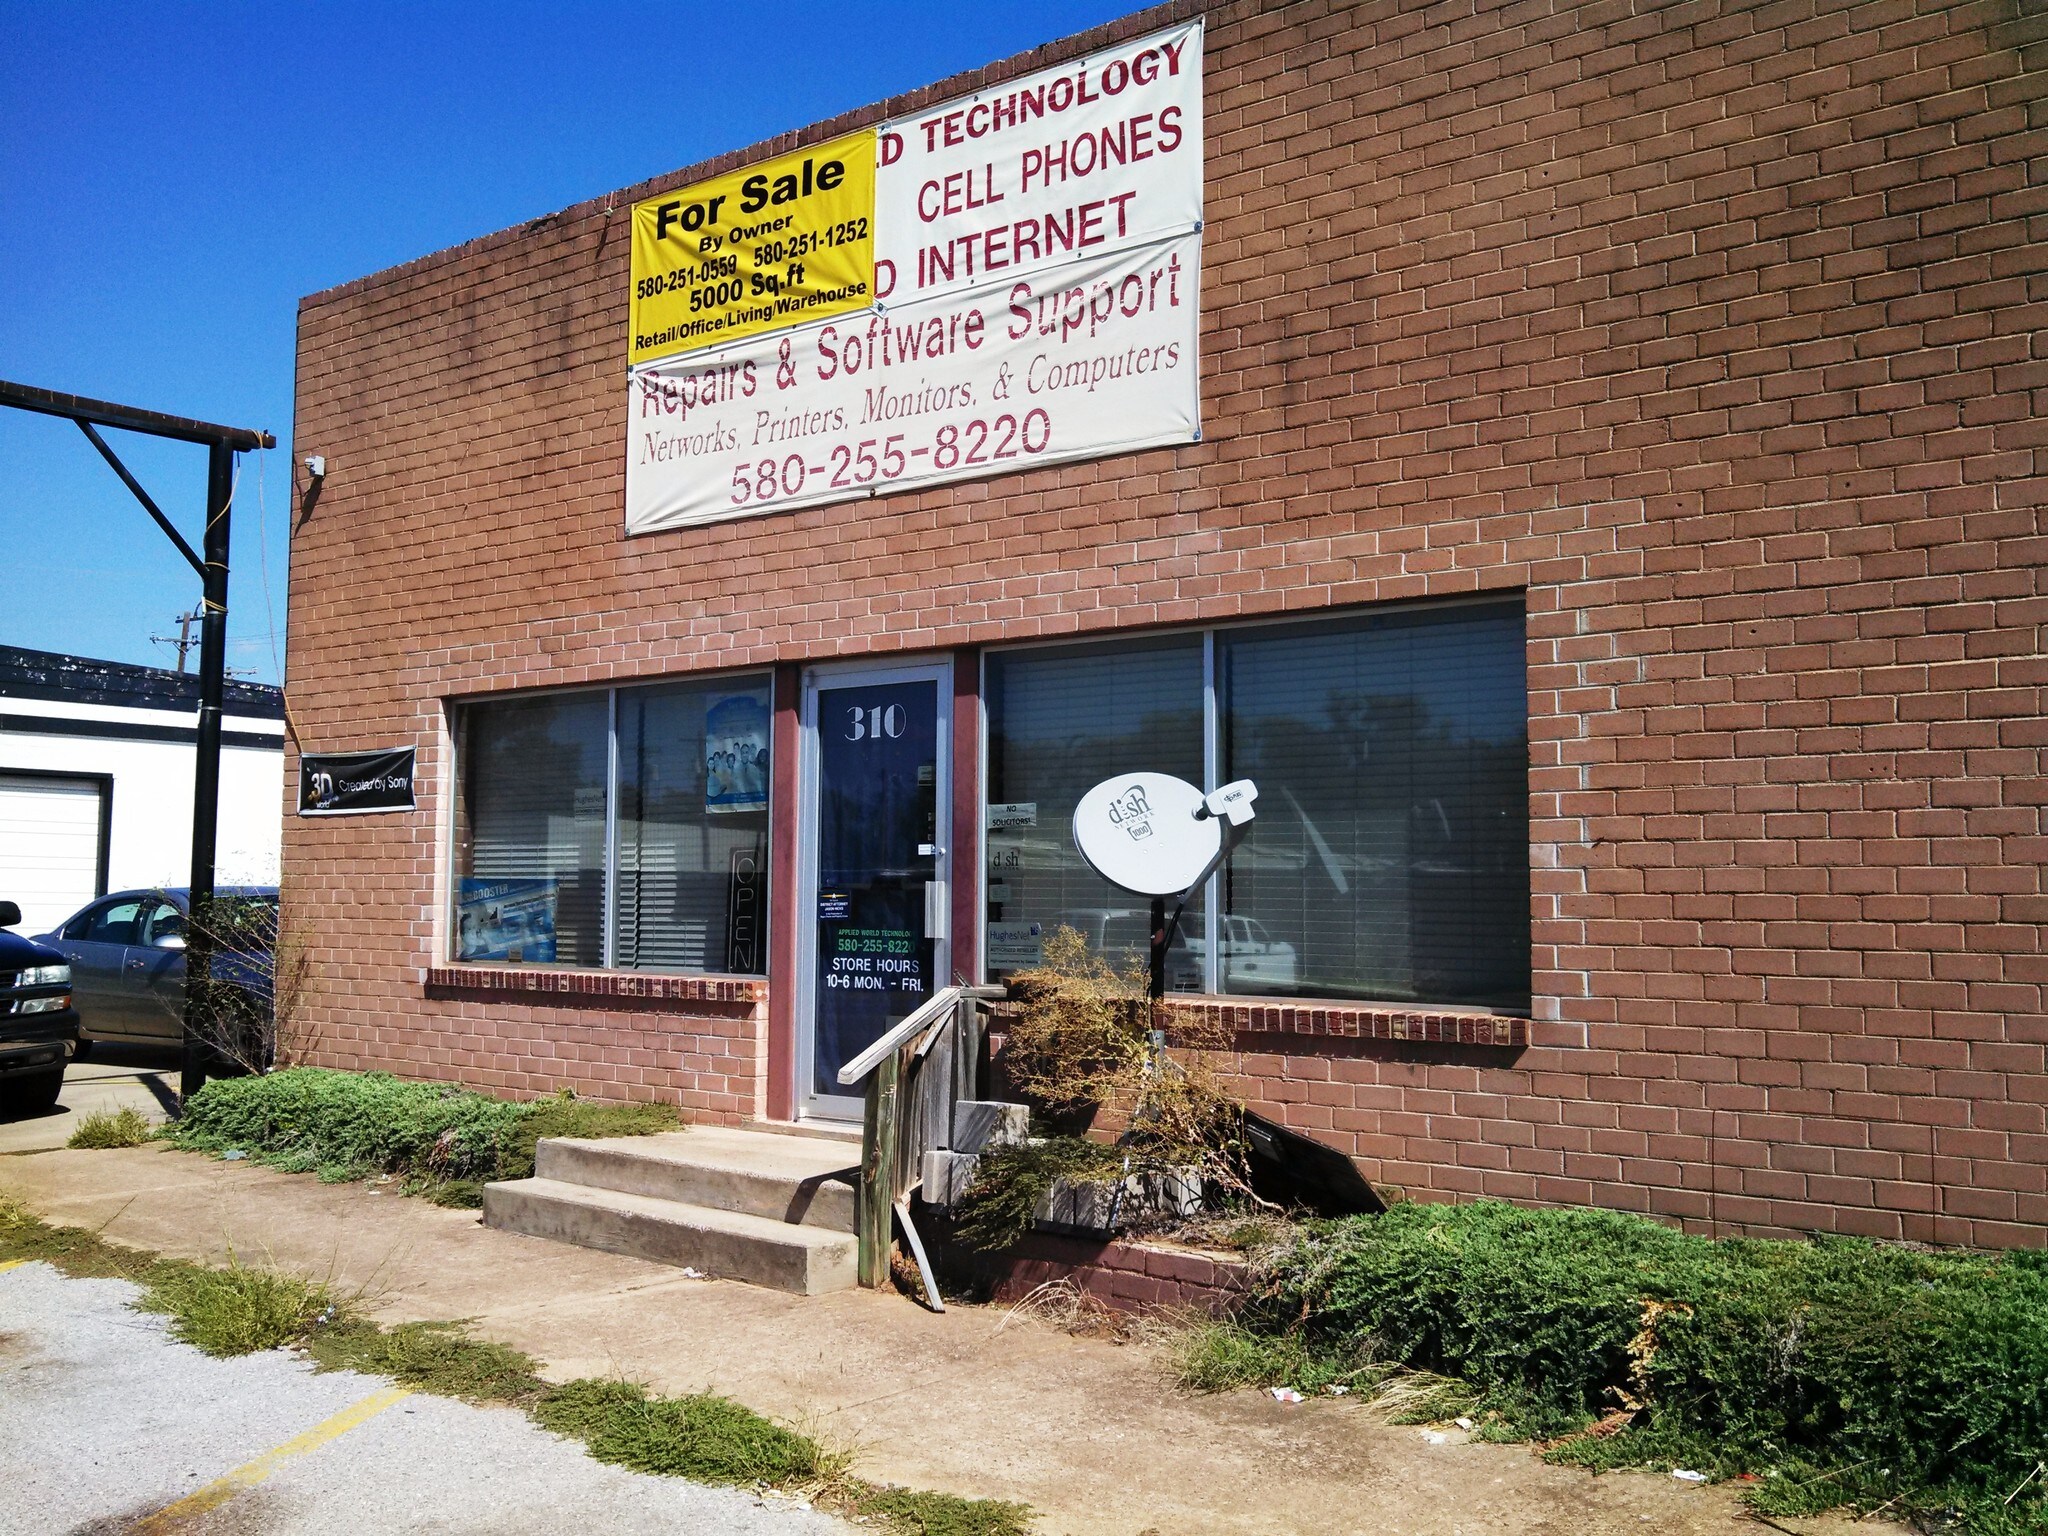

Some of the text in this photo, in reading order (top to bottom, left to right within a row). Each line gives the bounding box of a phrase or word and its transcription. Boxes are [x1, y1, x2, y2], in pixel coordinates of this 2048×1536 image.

[920, 36, 1188, 153] TECHNOLOGY
[917, 105, 1182, 223] CELL PHONES
[656, 159, 845, 240] For Sale
[637, 217, 868, 300] 580-251-0559 580-251-1252
[698, 214, 793, 253] By Owner
[917, 190, 1136, 289] INTERNET
[635, 281, 867, 350] Retail/Office/Living/Warehouse
[689, 262, 805, 313] 5000 Sq.ft
[641, 252, 1181, 421] Repairs & Software Support
[992, 361, 1014, 401] &
[1027, 341, 1180, 395] Computers
[730, 407, 1050, 505] 580-255-8220
[844, 703, 907, 741] 310
[309, 772, 334, 799] 3D
[339, 775, 409, 792] Created by Sony
[1108, 792, 1153, 824] dish
[734, 857, 755, 969] OPEN
[826, 974, 850, 988] 10-6
[854, 976, 885, 990] MON.
[902, 978, 924, 992] FRI.
[832, 957, 919, 973] STORE HOURS
